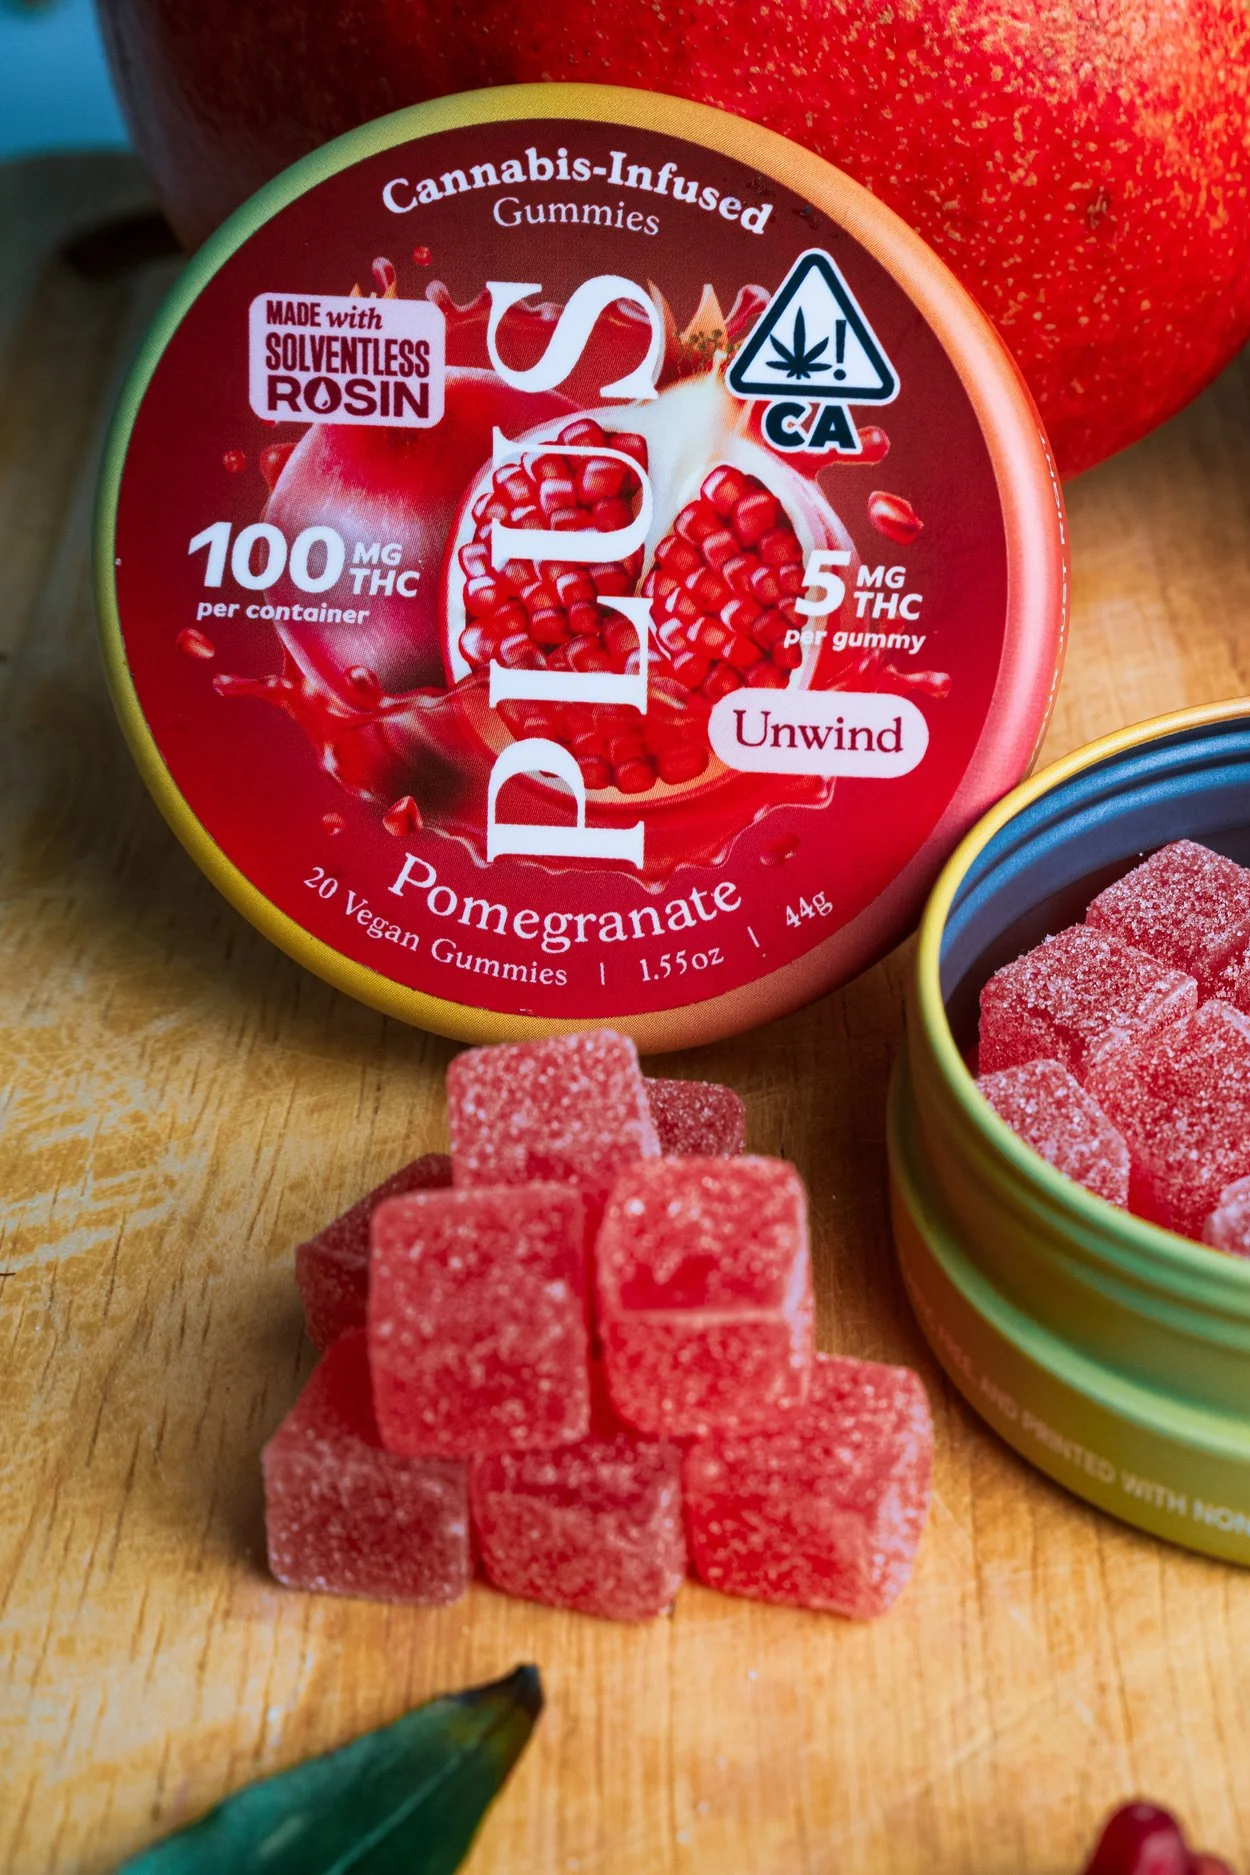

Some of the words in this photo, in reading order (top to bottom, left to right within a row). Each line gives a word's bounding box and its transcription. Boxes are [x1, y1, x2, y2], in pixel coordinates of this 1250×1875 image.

[382, 147, 773, 235] Cannabis-Infused
[493, 196, 660, 236] Gummies
[266, 299, 322, 327] MADE
[326, 305, 384, 330] with
[265, 331, 431, 379] SOLVENTLESS
[266, 374, 431, 419] ROSIN
[765, 402, 858, 450] CA
[187, 521, 346, 593] 100
[351, 542, 403, 566] MG
[486, 274, 668, 870] PLUS
[349, 567, 421, 598] THC
[793, 548, 853, 617] 5
[856, 565, 907, 589] MG
[853, 591, 924, 620] THC
[196, 602, 240, 622] per
[245, 602, 371, 625] container
[783, 629, 828, 649] per
[832, 632, 927, 655] gummy
[733, 709, 904, 754] Unwind
[303, 866, 339, 899] 20
[344, 889, 420, 952] Vegan
[430, 937, 569, 986] Gummies
[639, 947, 725, 982] 1.55oz
[784, 890, 834, 930] 44g
[387, 851, 743, 954] Pomegranate
[1020, 1409, 1117, 1485] PRINTED
[1120, 1467, 1188, 1516] WITH
